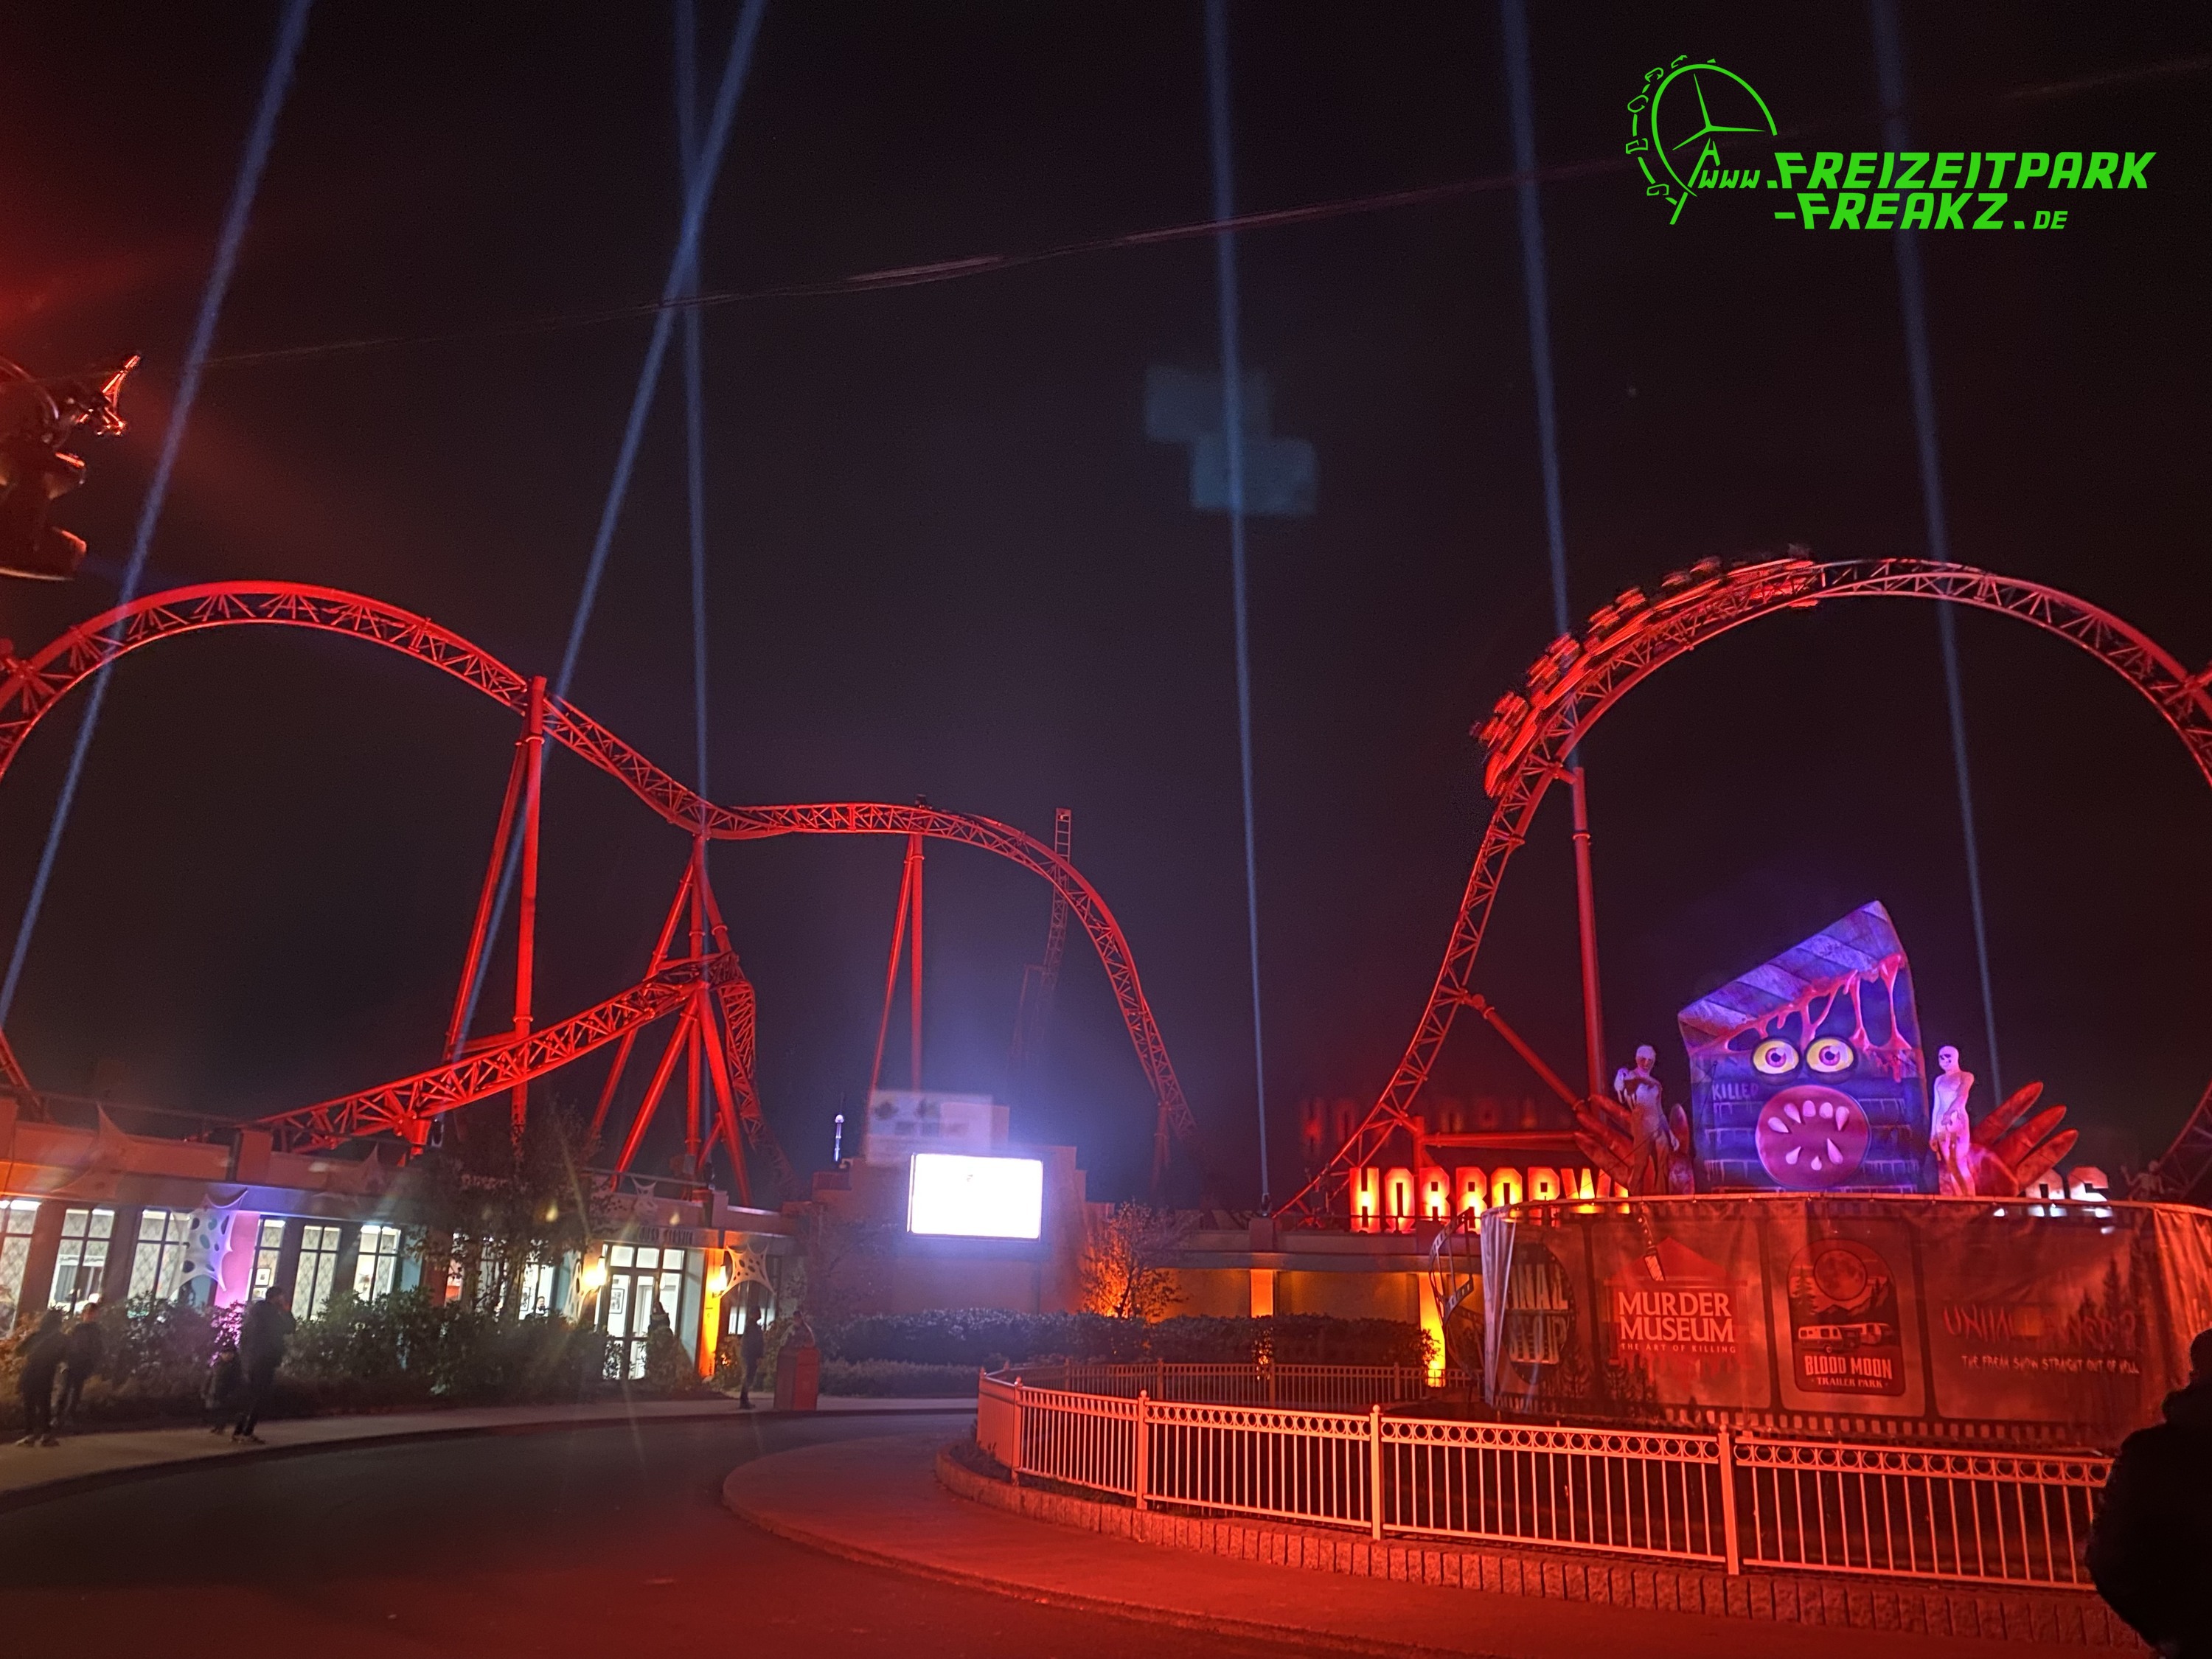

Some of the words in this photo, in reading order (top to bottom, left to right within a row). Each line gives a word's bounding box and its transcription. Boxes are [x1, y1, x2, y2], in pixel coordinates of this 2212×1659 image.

[1504, 1263, 1569, 1310] INAL
[1618, 1291, 1733, 1317] MURDER
[1620, 1316, 1735, 1343] MUSEUM
[1621, 1343, 1640, 1351] THE
[1646, 1343, 1666, 1352] ART
[1673, 1344, 1686, 1352] OF
[1691, 1345, 1736, 1354] KILLING
[1804, 1355, 1847, 1377] BLOOD
[1850, 1357, 1893, 1380] MOON
[1961, 1355, 1981, 1370] THE
[1816, 1377, 1856, 1388] TRAILER
[1857, 1378, 1884, 1389] PARK
